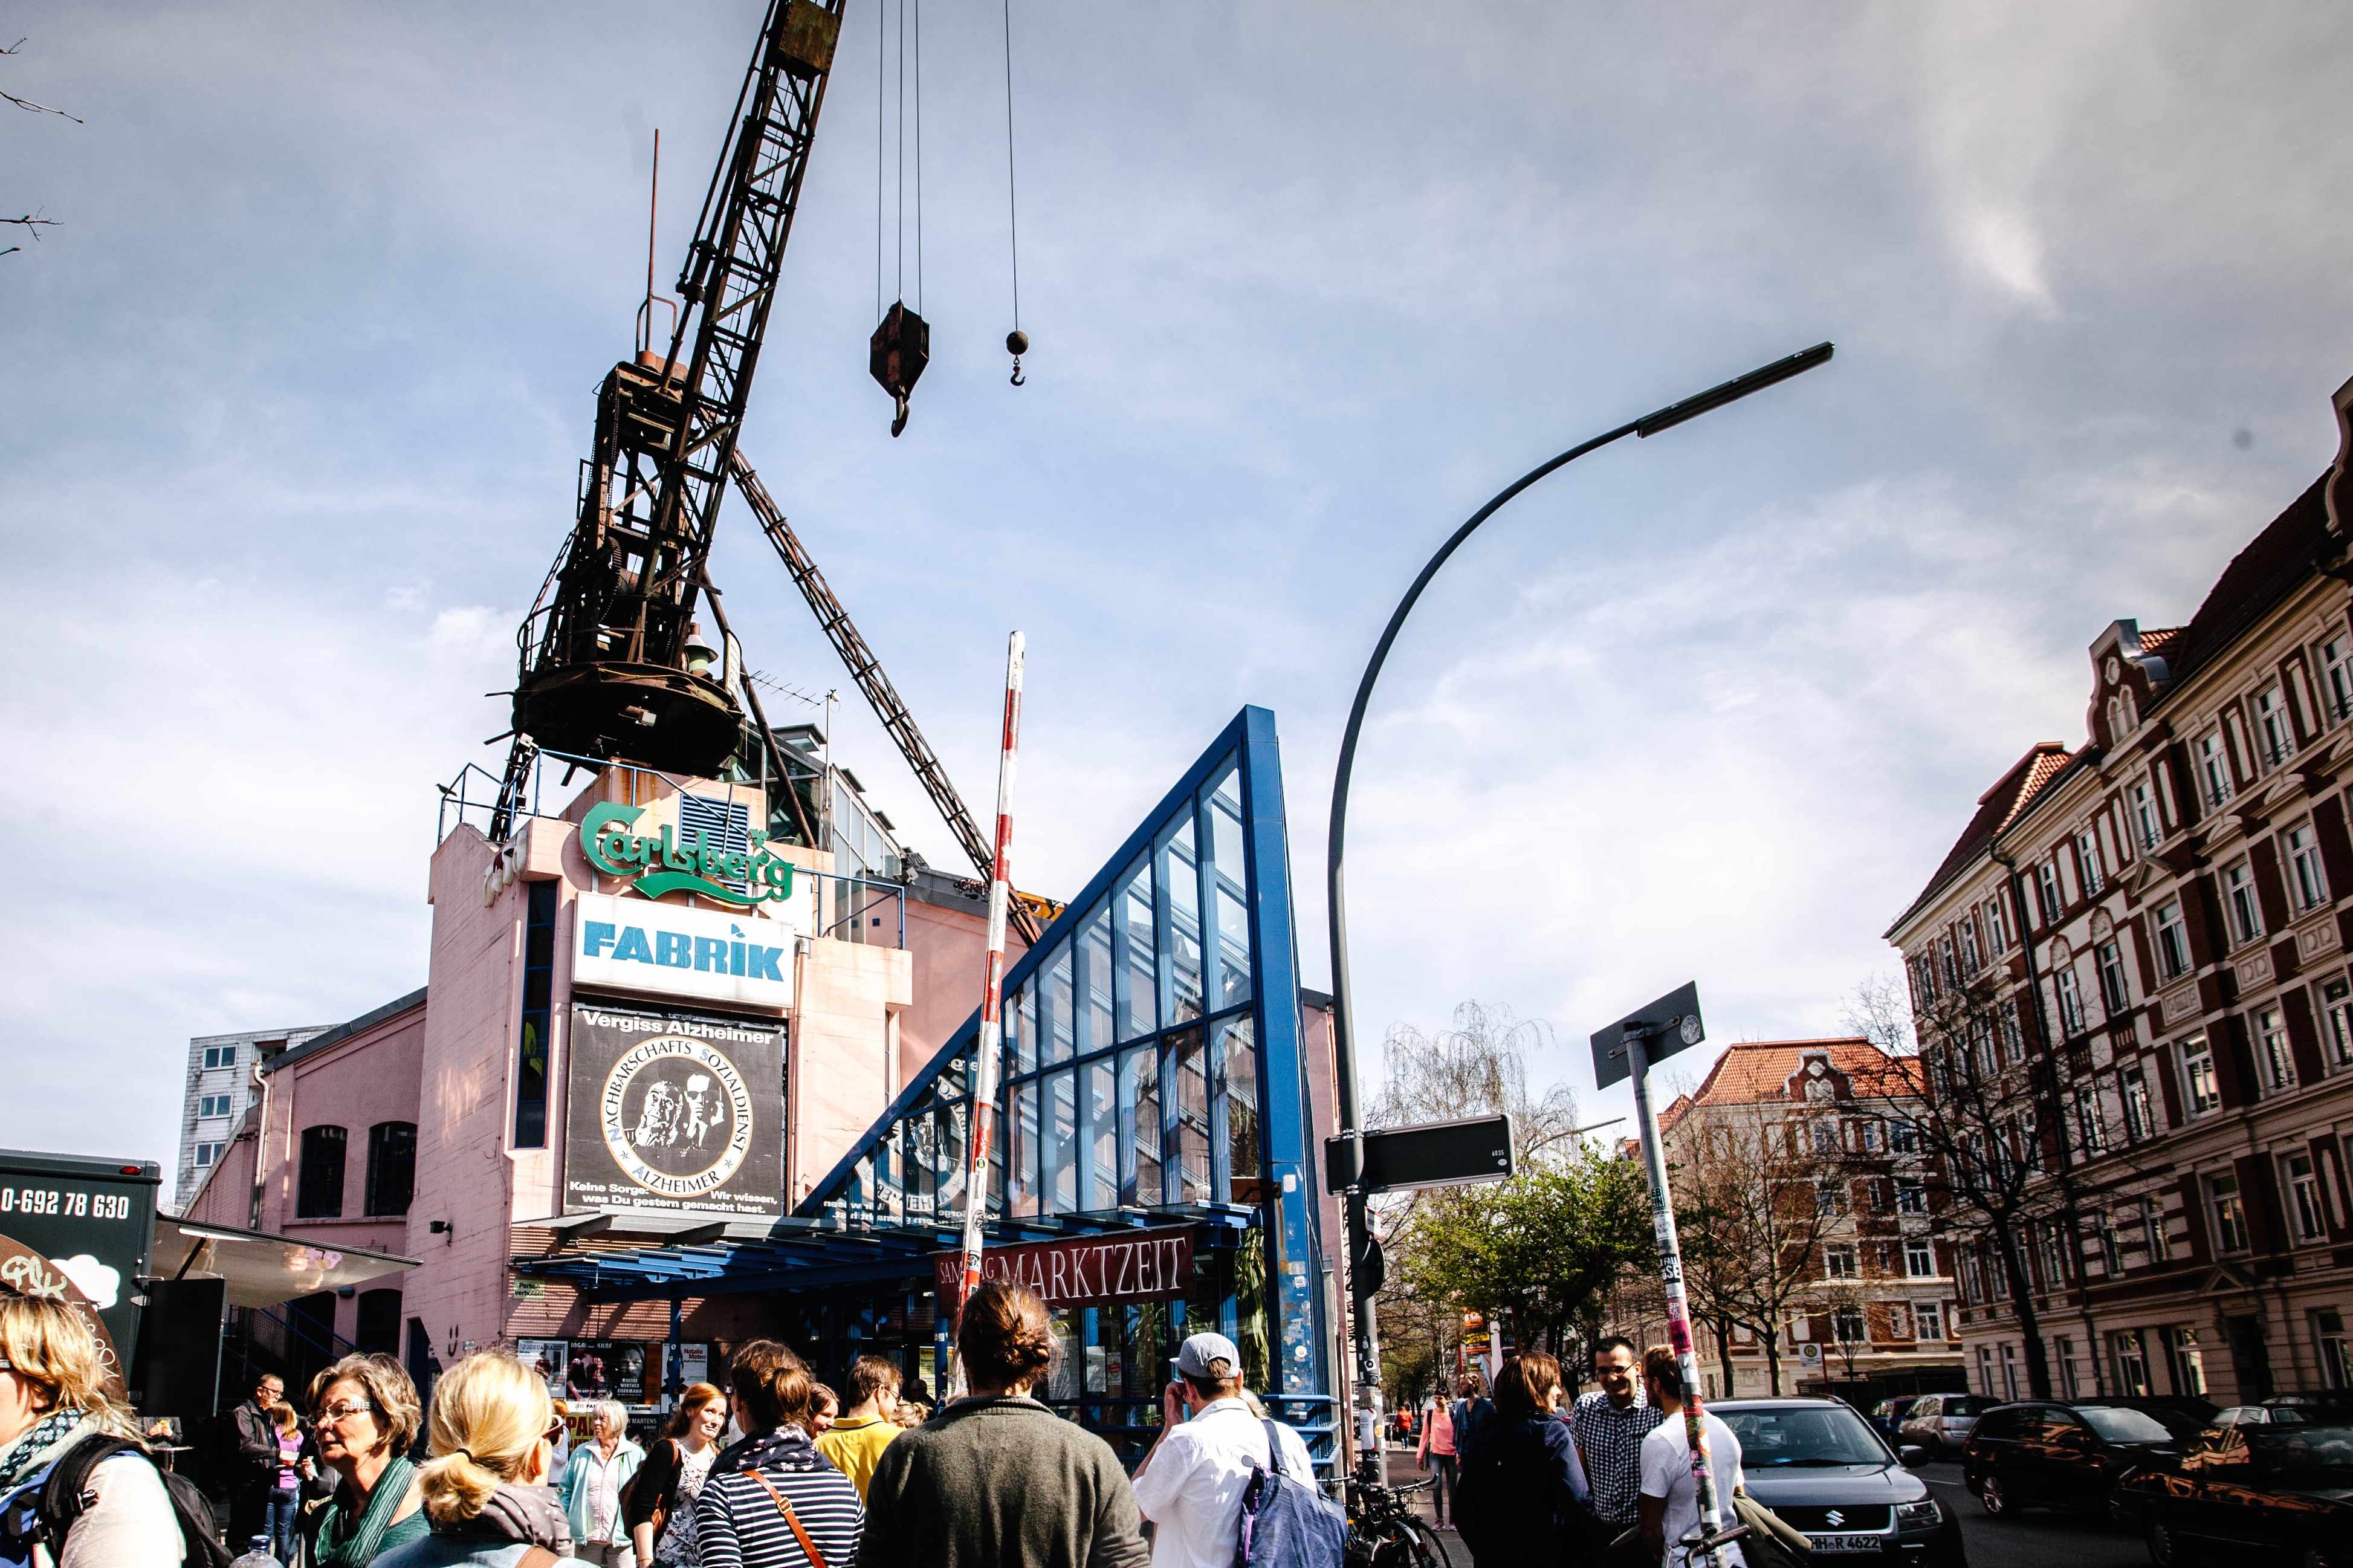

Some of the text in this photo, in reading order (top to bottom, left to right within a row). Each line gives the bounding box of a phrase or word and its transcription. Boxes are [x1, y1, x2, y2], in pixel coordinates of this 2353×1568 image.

[581, 801, 795, 902] Carlsberg
[584, 920, 785, 982] FABRIK
[582, 1010, 774, 1045] Vergiss Alzheimer
[569, 1181, 778, 1205] Keine Sorge: Wir wissen,
[632, 1165, 720, 1193] ALZHEIMER
[64, 1192, 88, 1217] 78
[92, 1194, 129, 1219] 630
[582, 1194, 766, 1214] was Du gestern gemacht hast.
[940, 1237, 1186, 1300] SAMAG MARKTZEIT
[1835, 1537, 1845, 1549] R
[1847, 1537, 1880, 1549] 4622
